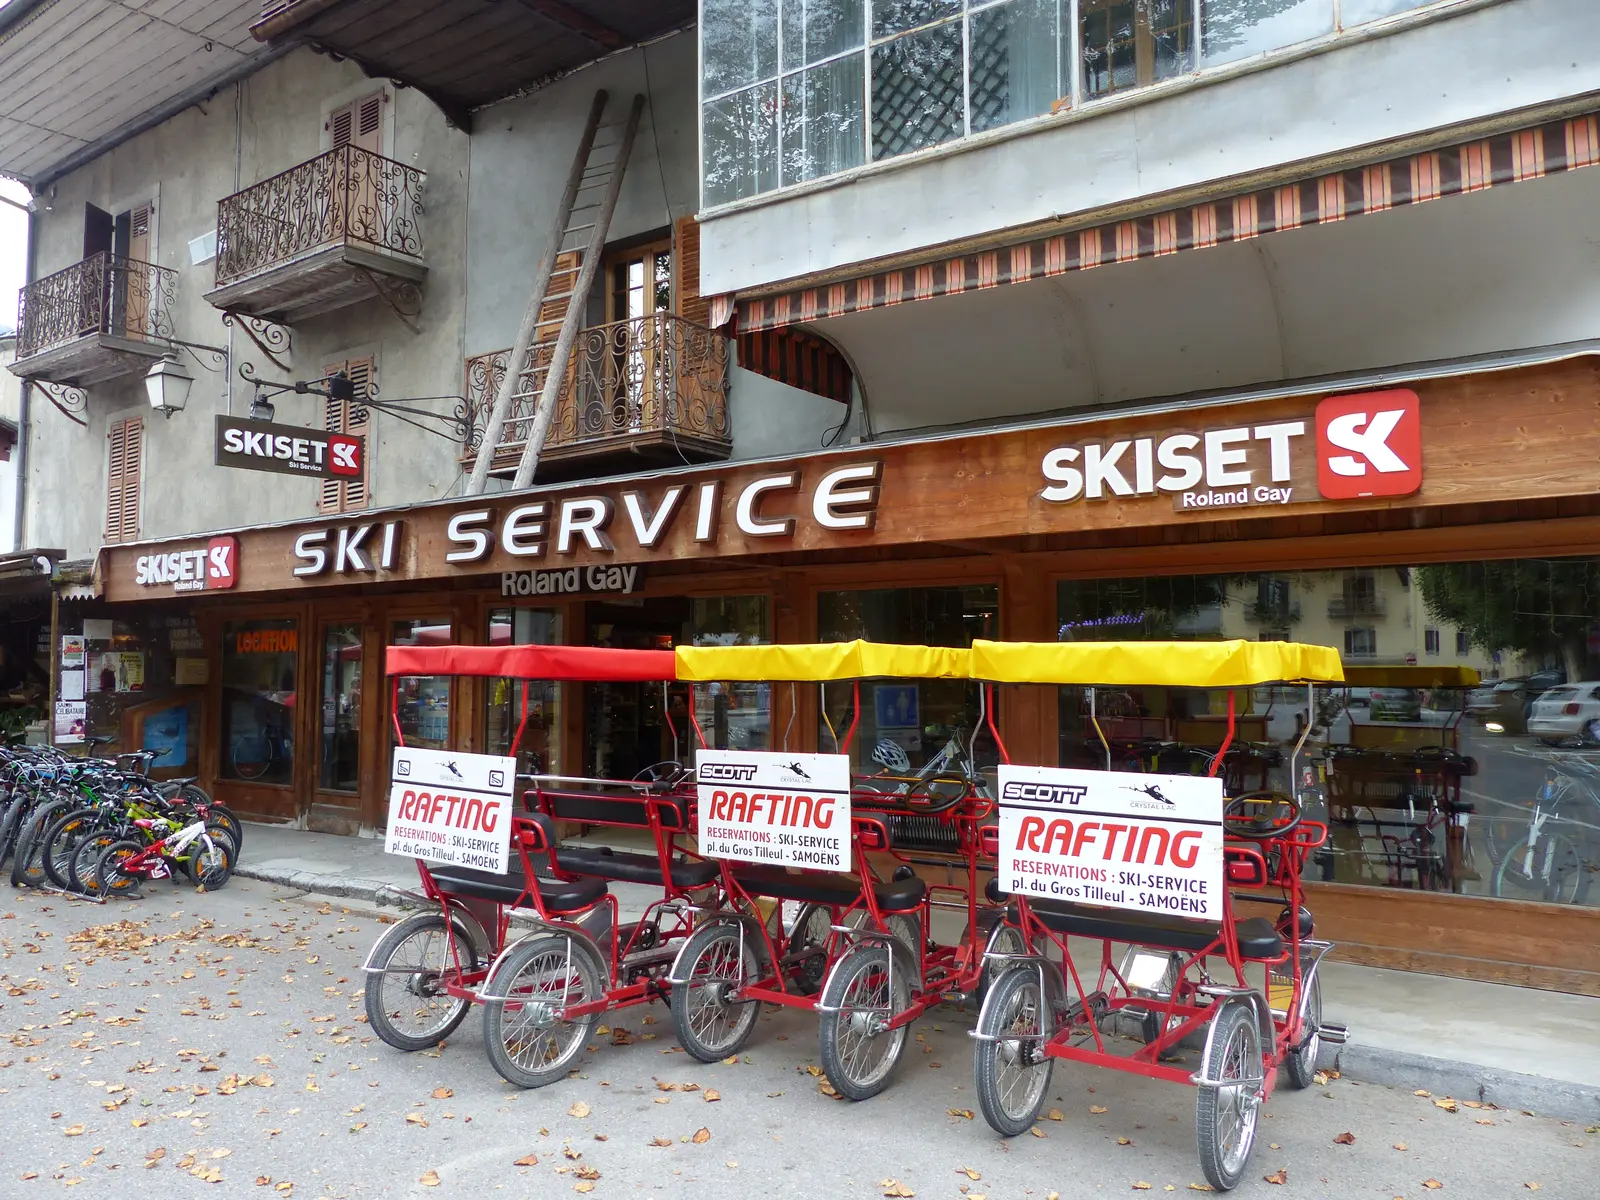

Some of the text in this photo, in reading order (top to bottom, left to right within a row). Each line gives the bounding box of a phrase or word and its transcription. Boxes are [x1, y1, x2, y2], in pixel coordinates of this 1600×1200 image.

[224, 428, 328, 464] SKISET
[289, 461, 323, 472] Ski Service
[1040, 421, 1305, 502] SKISET
[1182, 486, 1292, 508] Roland Gay
[292, 463, 879, 577] SKI SERVICE
[135, 550, 208, 585] SKISET
[501, 565, 638, 596] Roland Gay
[174, 580, 204, 591] Roland Gay
[236, 630, 298, 653] LOCATION
[700, 763, 758, 780] SCOTT
[1002, 781, 1088, 805] SCOTT
[1130, 802, 1177, 811] CRYSTAL LAC
[397, 790, 501, 833] RAFTING
[708, 790, 836, 829] RAFTING
[394, 826, 447, 845] RESERVATIONS
[452, 835, 500, 855] SKI-SERVICE
[707, 826, 771, 843] RESERVATIONS
[778, 833, 839, 850] SKI-SERVICE
[1015, 815, 1204, 869] RAFTING
[392, 841, 402, 853] pl.
[402, 841, 412, 852] du
[413, 844, 430, 856] Gros
[432, 846, 455, 861] Tilleul
[461, 852, 499, 870] SAMOËNS
[707, 842, 718, 854] pl.
[719, 843, 730, 853] du
[732, 844, 753, 856] Gros
[754, 846, 783, 860] Tilleul
[792, 849, 840, 866] SAMOËNS
[1012, 859, 1107, 882] RESERVATIONS
[1118, 871, 1208, 894] SKI-SERVICE
[1012, 876, 1028, 892] pl.
[1030, 878, 1046, 892] du
[1050, 881, 1080, 897] Gros
[1083, 885, 1125, 903] Tilleul
[1138, 893, 1208, 914] SAMOËNS
